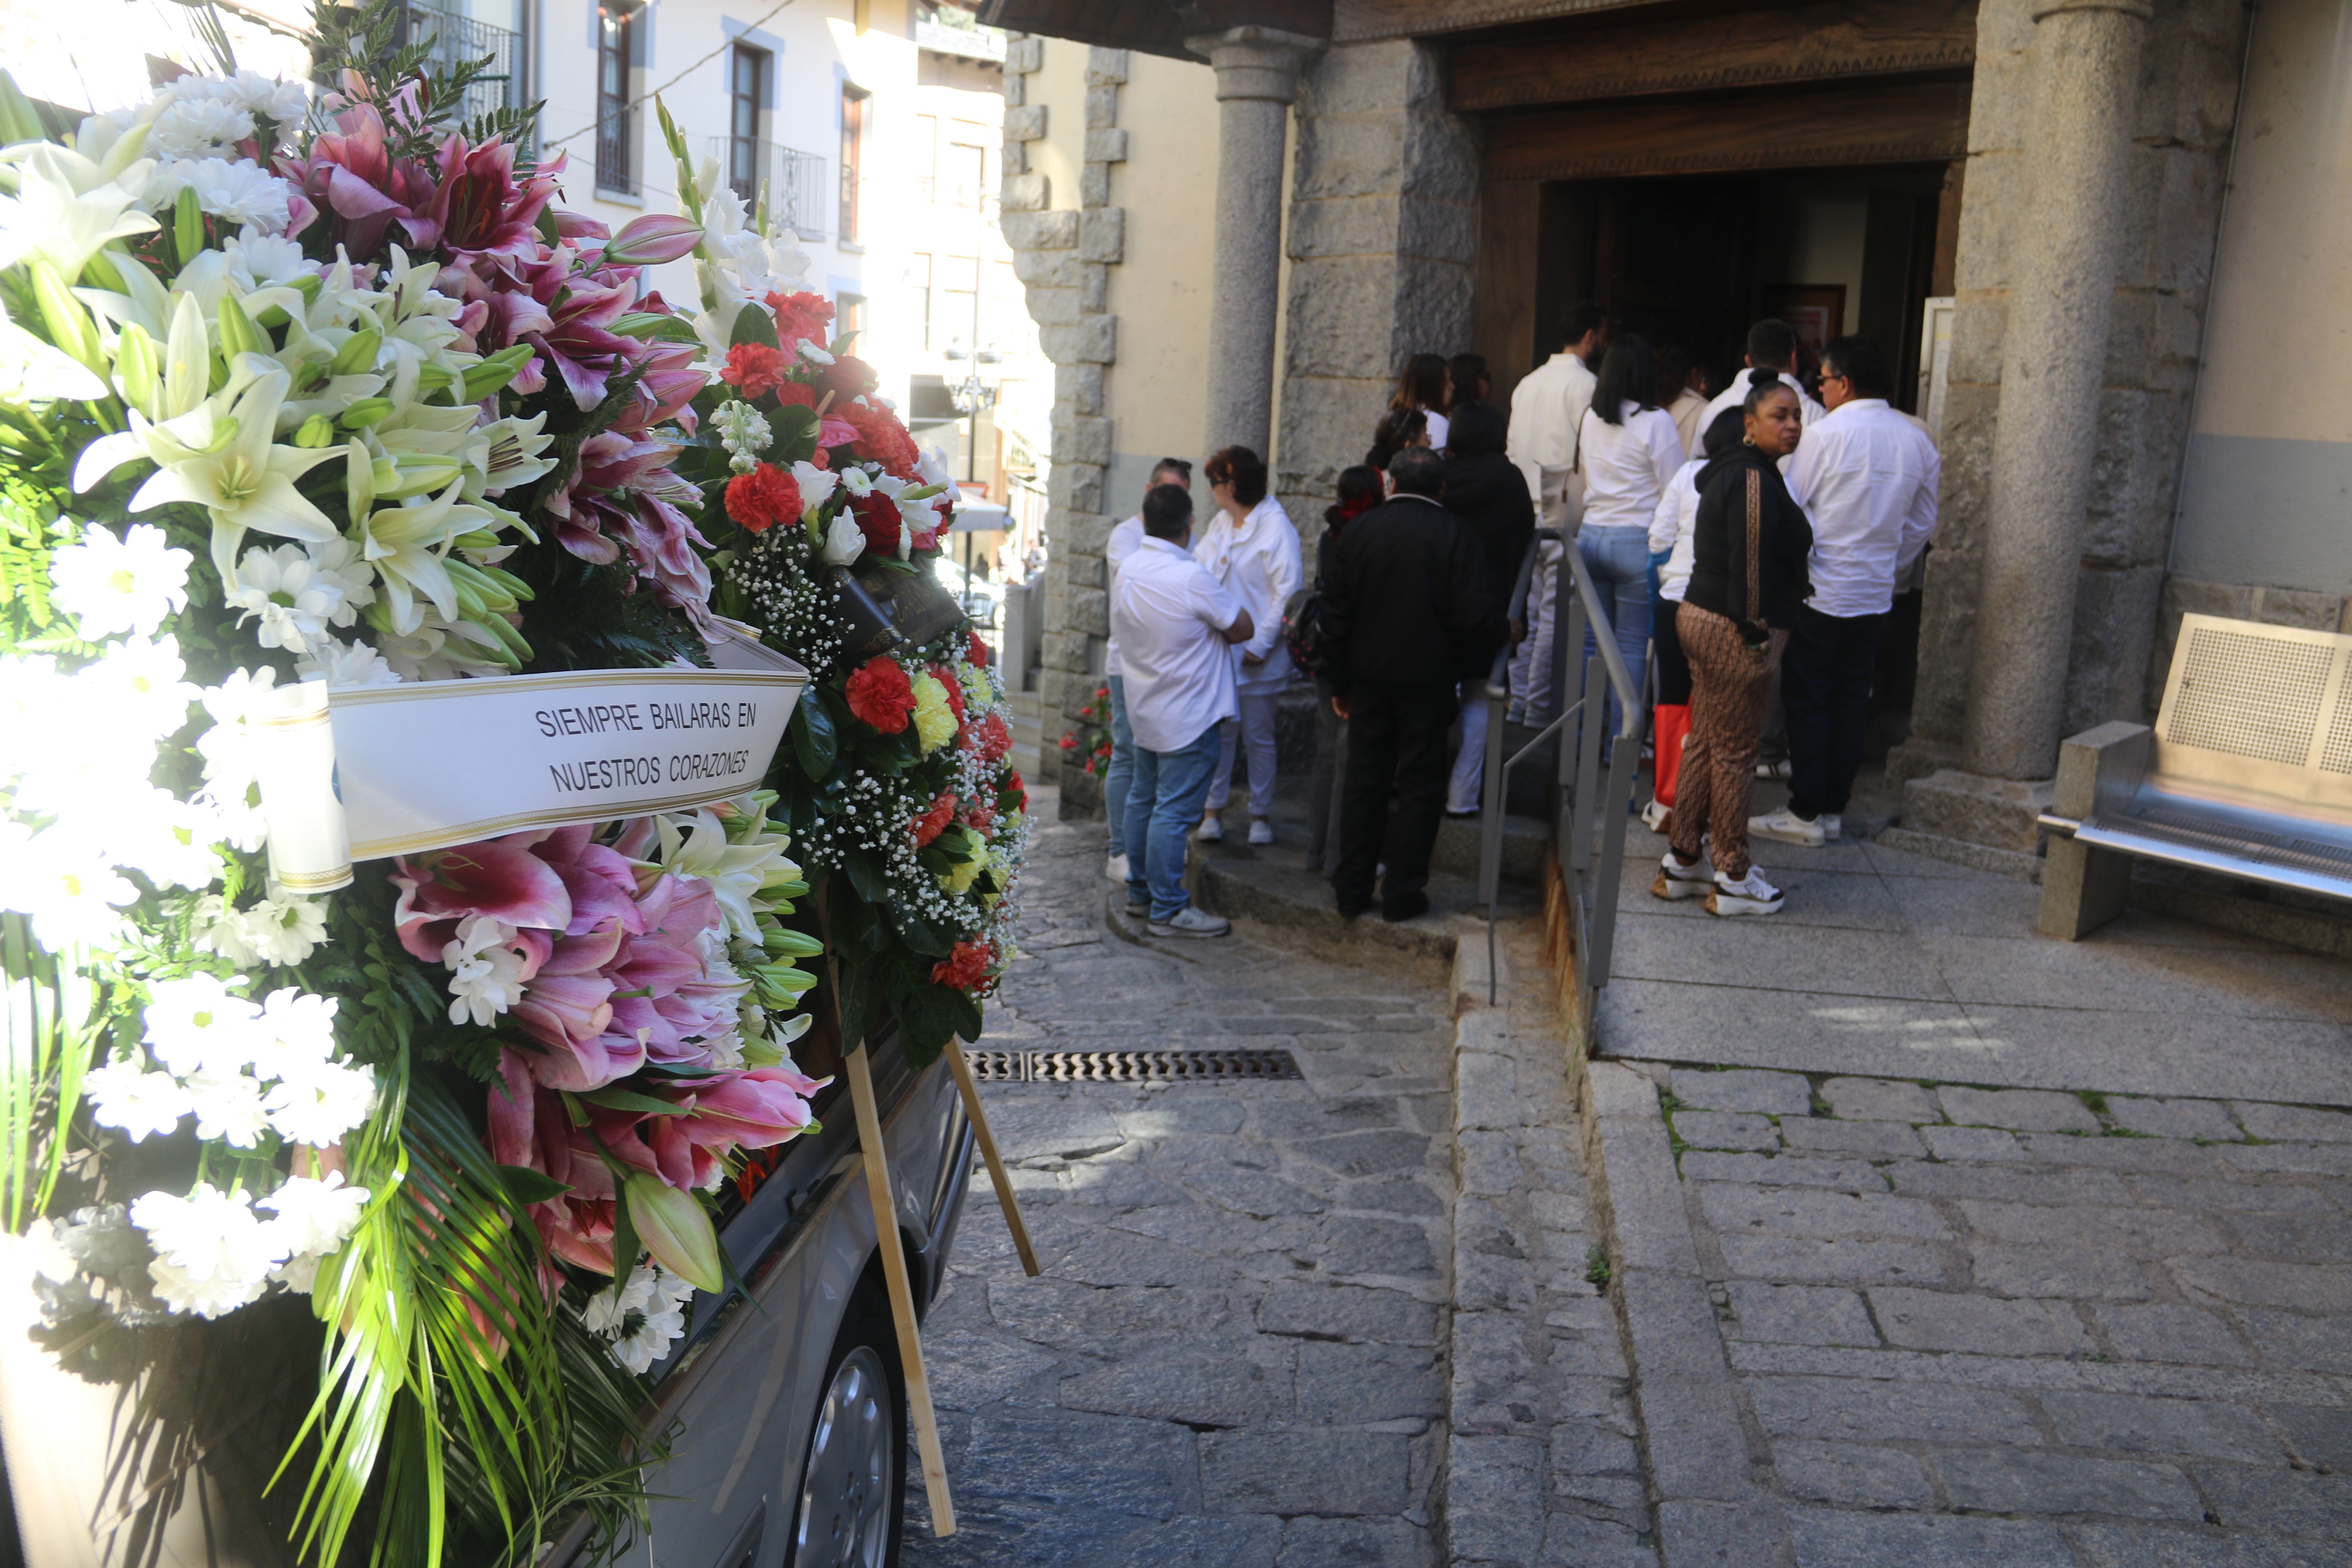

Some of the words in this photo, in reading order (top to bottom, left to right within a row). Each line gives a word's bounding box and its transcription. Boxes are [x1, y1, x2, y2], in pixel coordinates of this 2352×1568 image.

[535, 704, 643, 738] SIEMPRE
[649, 702, 730, 729] BAILARAS
[738, 702, 756, 727] EN
[549, 756, 661, 793] NUESTROS
[669, 750, 749, 782] CORAZONES
